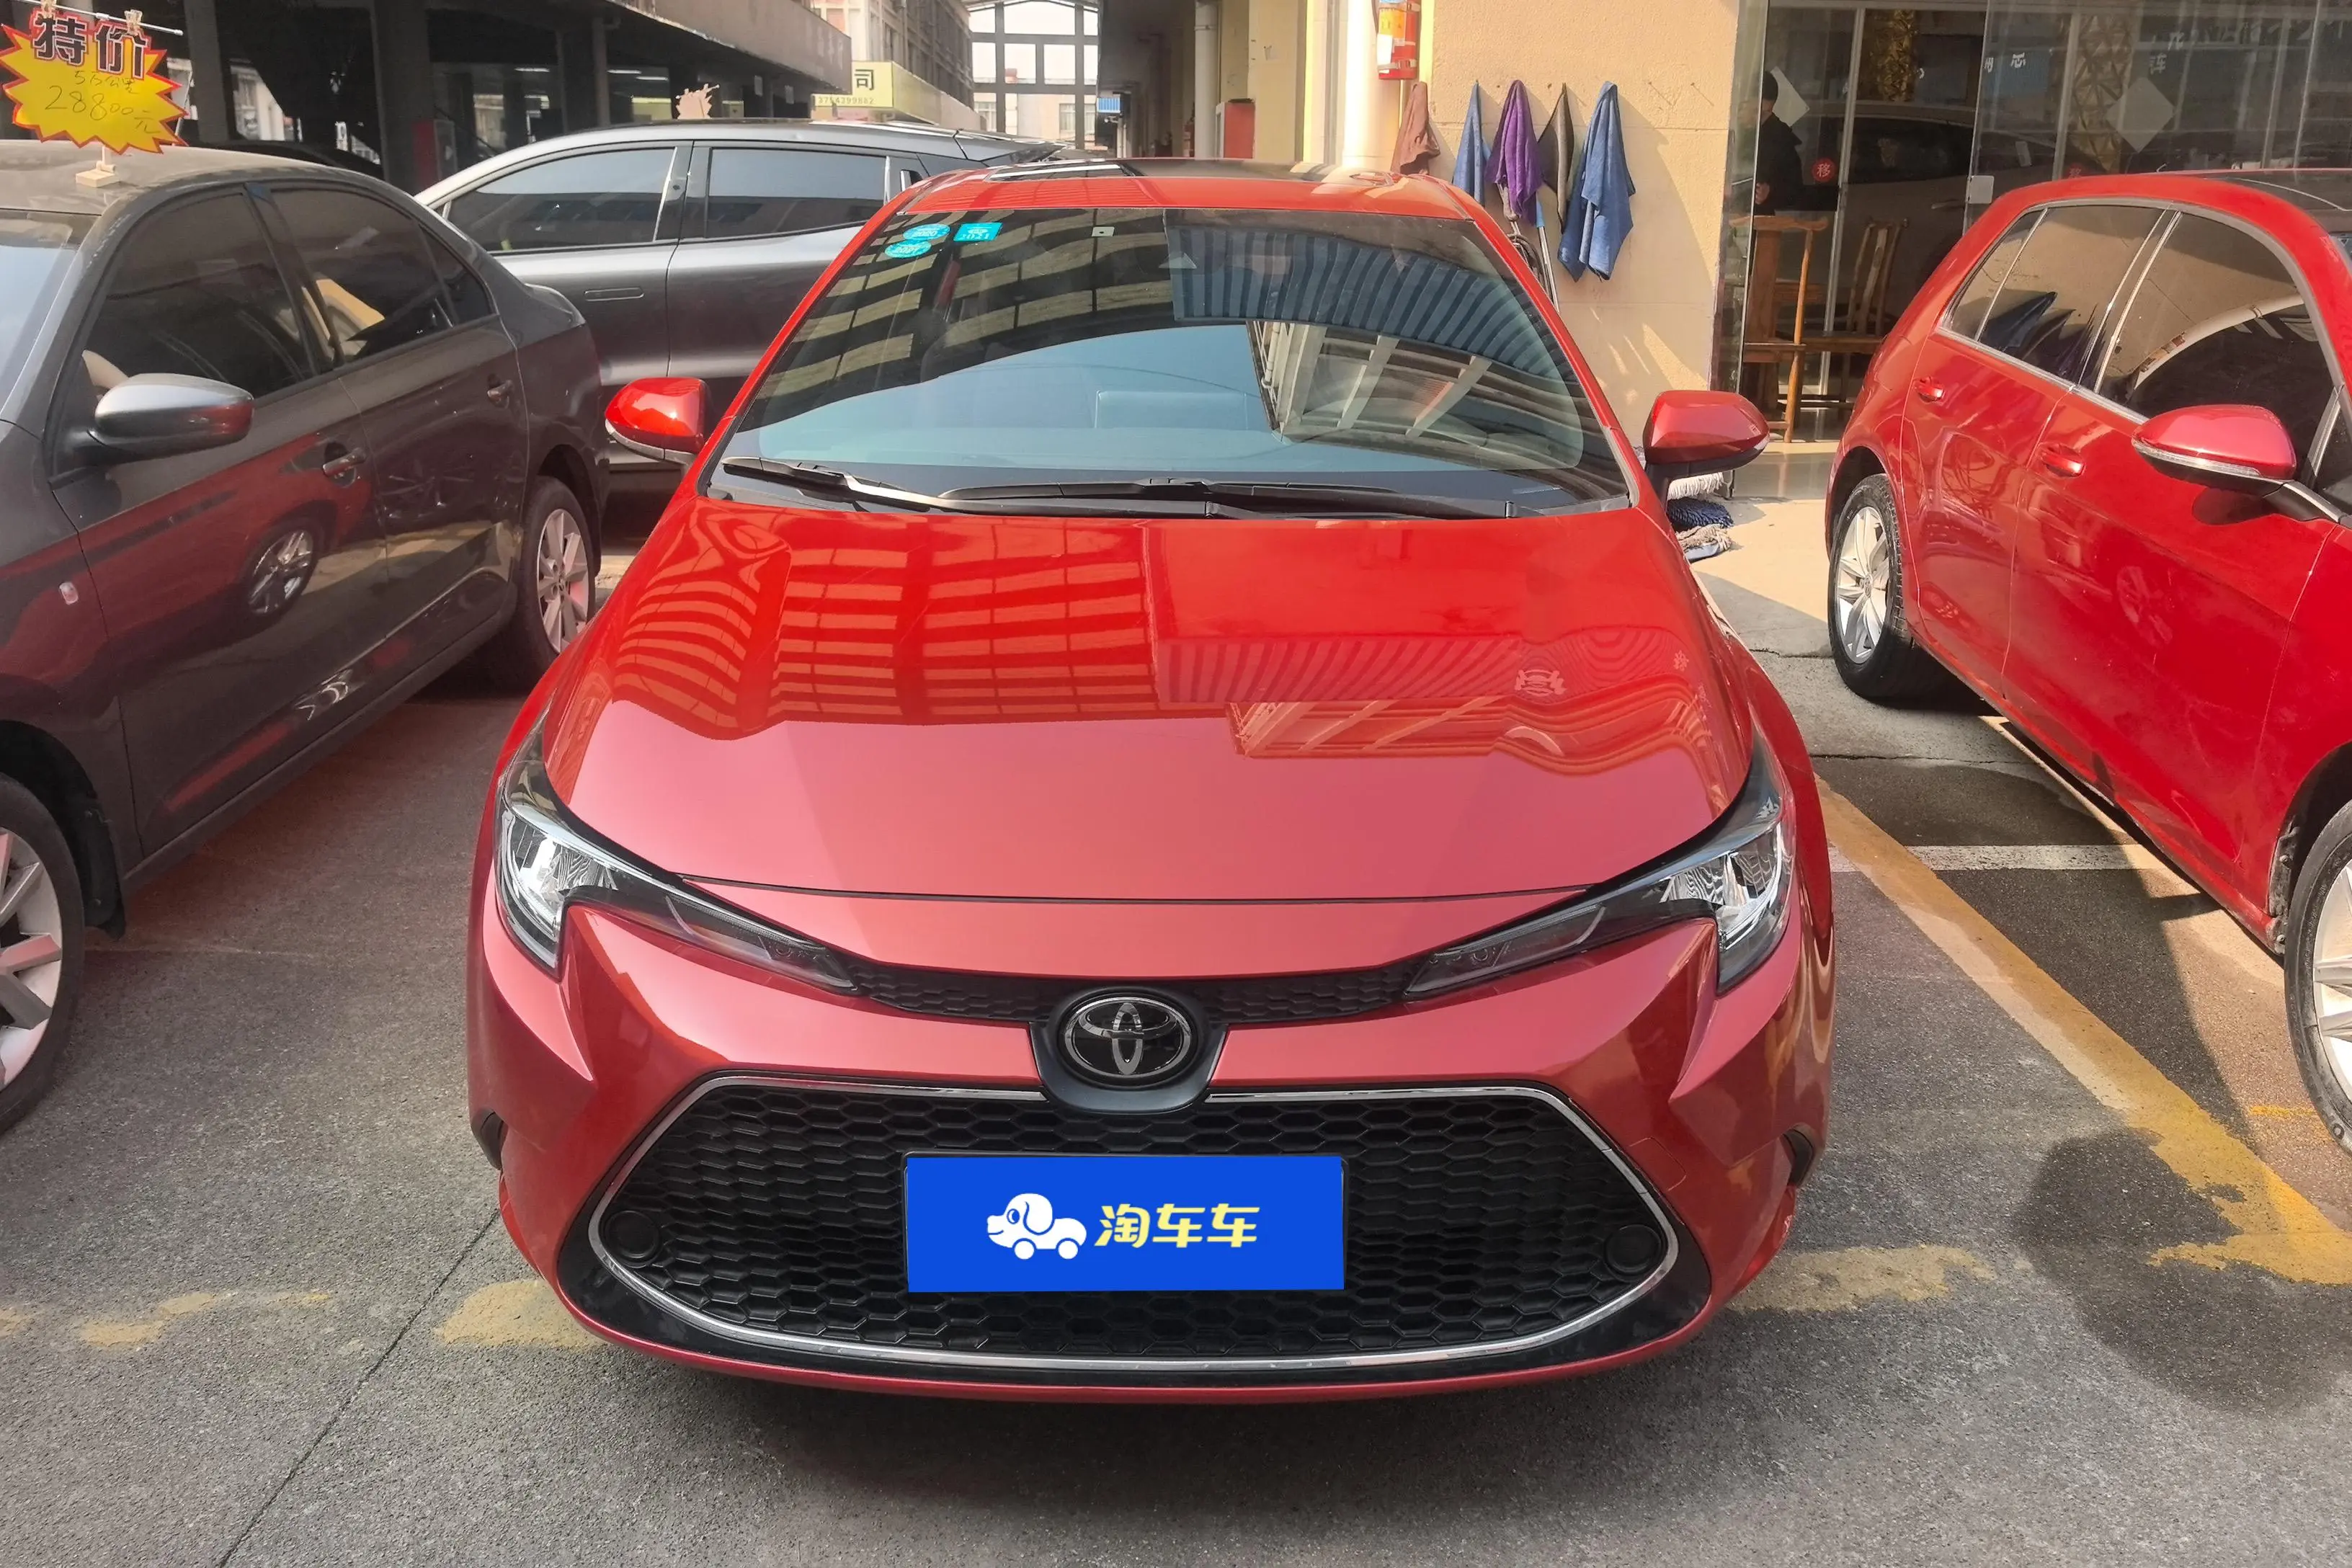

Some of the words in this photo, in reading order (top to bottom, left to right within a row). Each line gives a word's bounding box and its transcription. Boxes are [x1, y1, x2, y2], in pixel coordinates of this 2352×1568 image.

[32, 12, 148, 79] 特价
[854, 68, 874, 91] 司
[1816, 163, 1831, 178] 移
